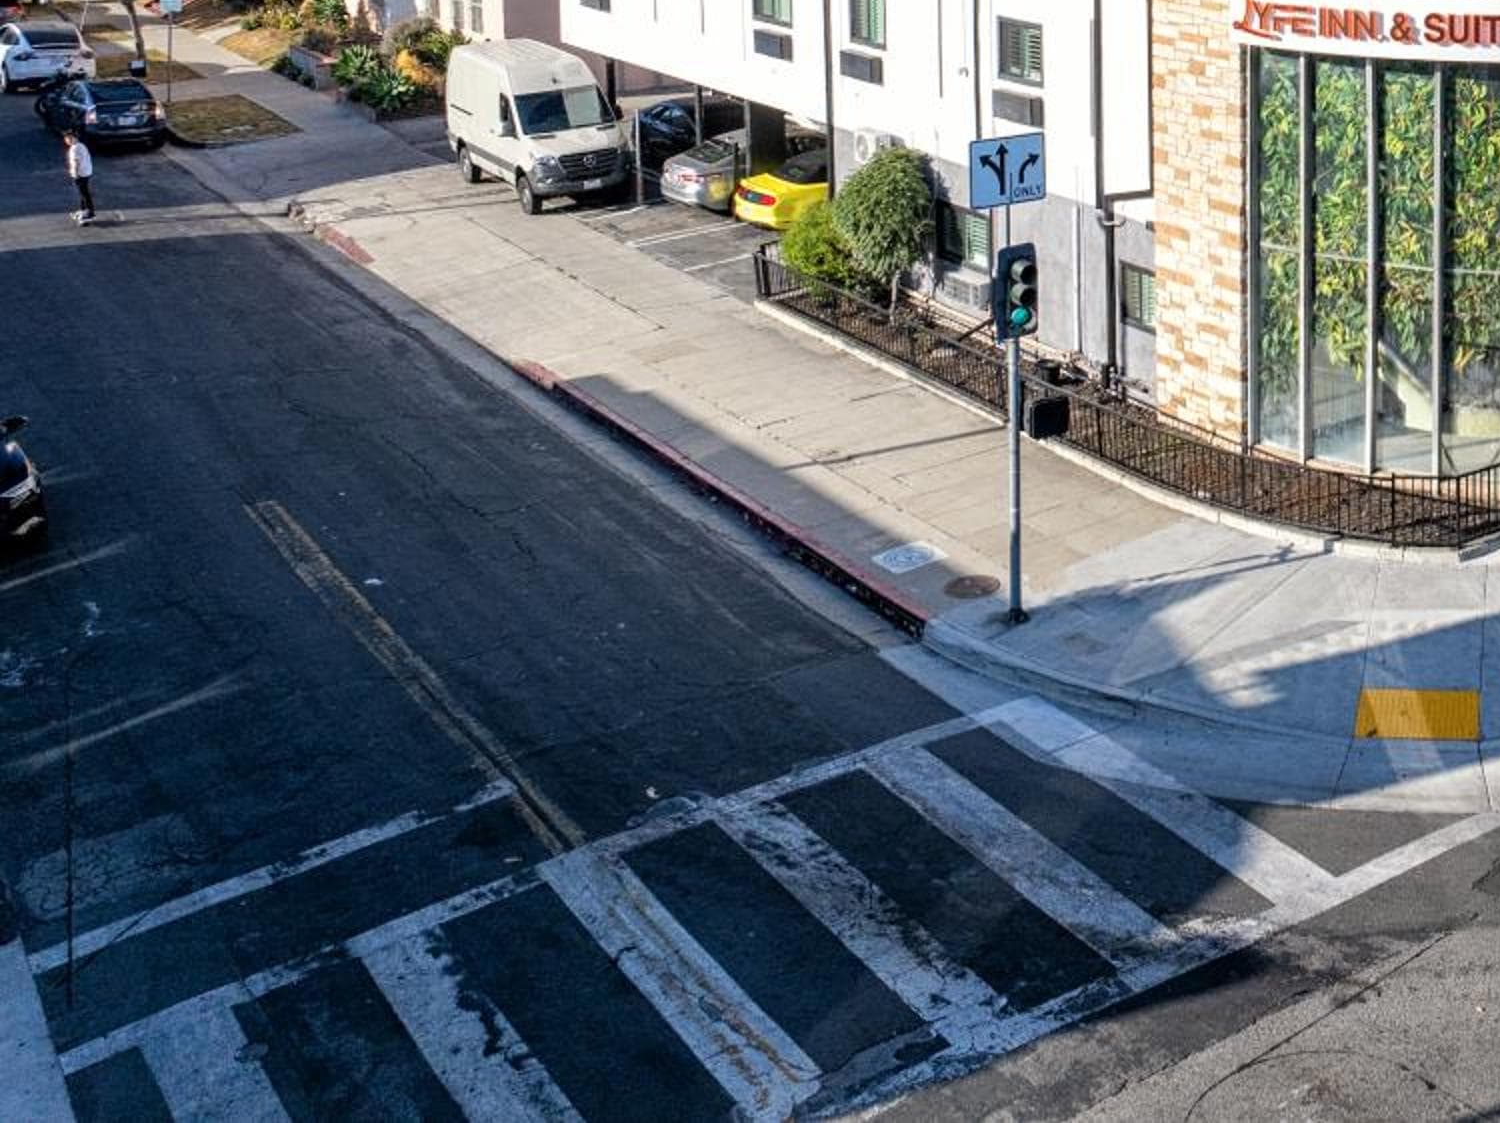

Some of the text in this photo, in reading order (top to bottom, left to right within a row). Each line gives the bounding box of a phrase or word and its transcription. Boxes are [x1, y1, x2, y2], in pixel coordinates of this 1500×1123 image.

[1318, 7, 1379, 44] INN
[1390, 12, 1415, 43] &
[1014, 186, 1041, 198] ONLY
